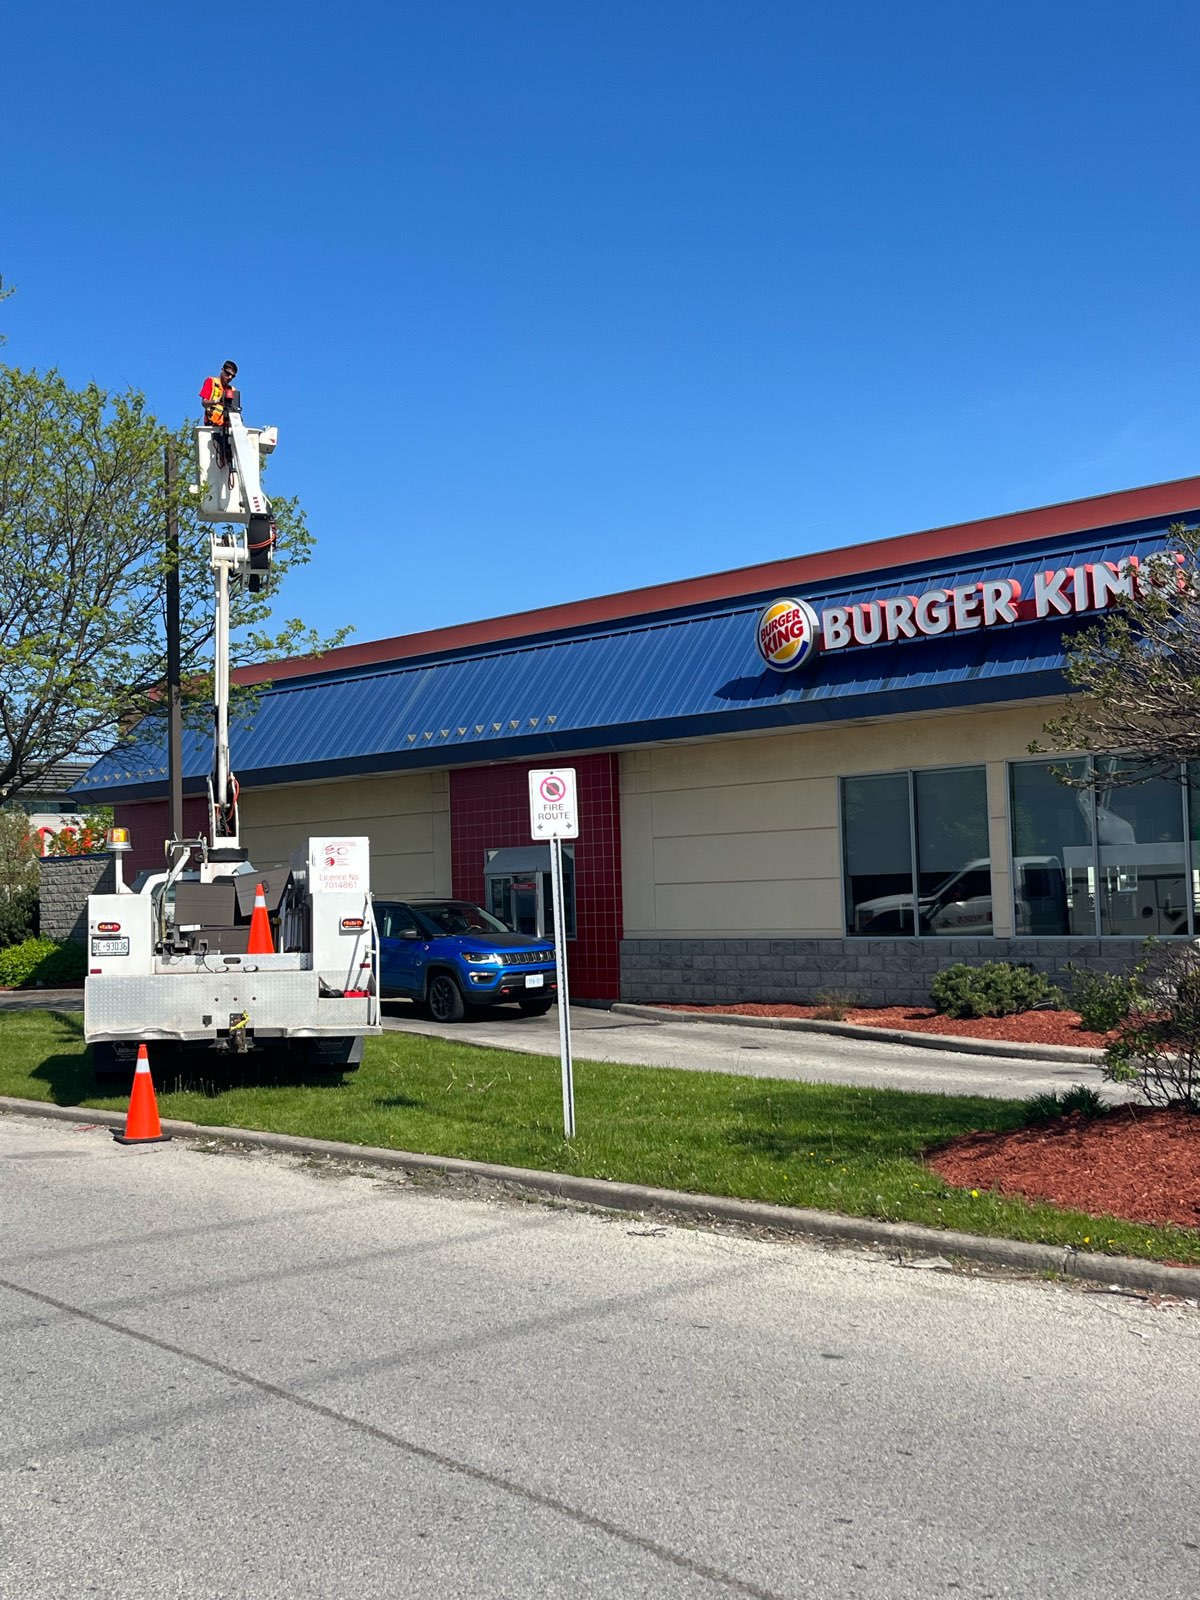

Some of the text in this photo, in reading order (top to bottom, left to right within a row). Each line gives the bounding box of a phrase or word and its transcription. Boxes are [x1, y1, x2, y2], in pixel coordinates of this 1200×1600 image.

[761, 608, 801, 642] BURGER
[822, 579, 1020, 650] BURGER
[763, 620, 804, 659] KING
[538, 812, 570, 820] ROUTE
[543, 803, 565, 811] FIRE
[319, 873, 347, 881] Licence
